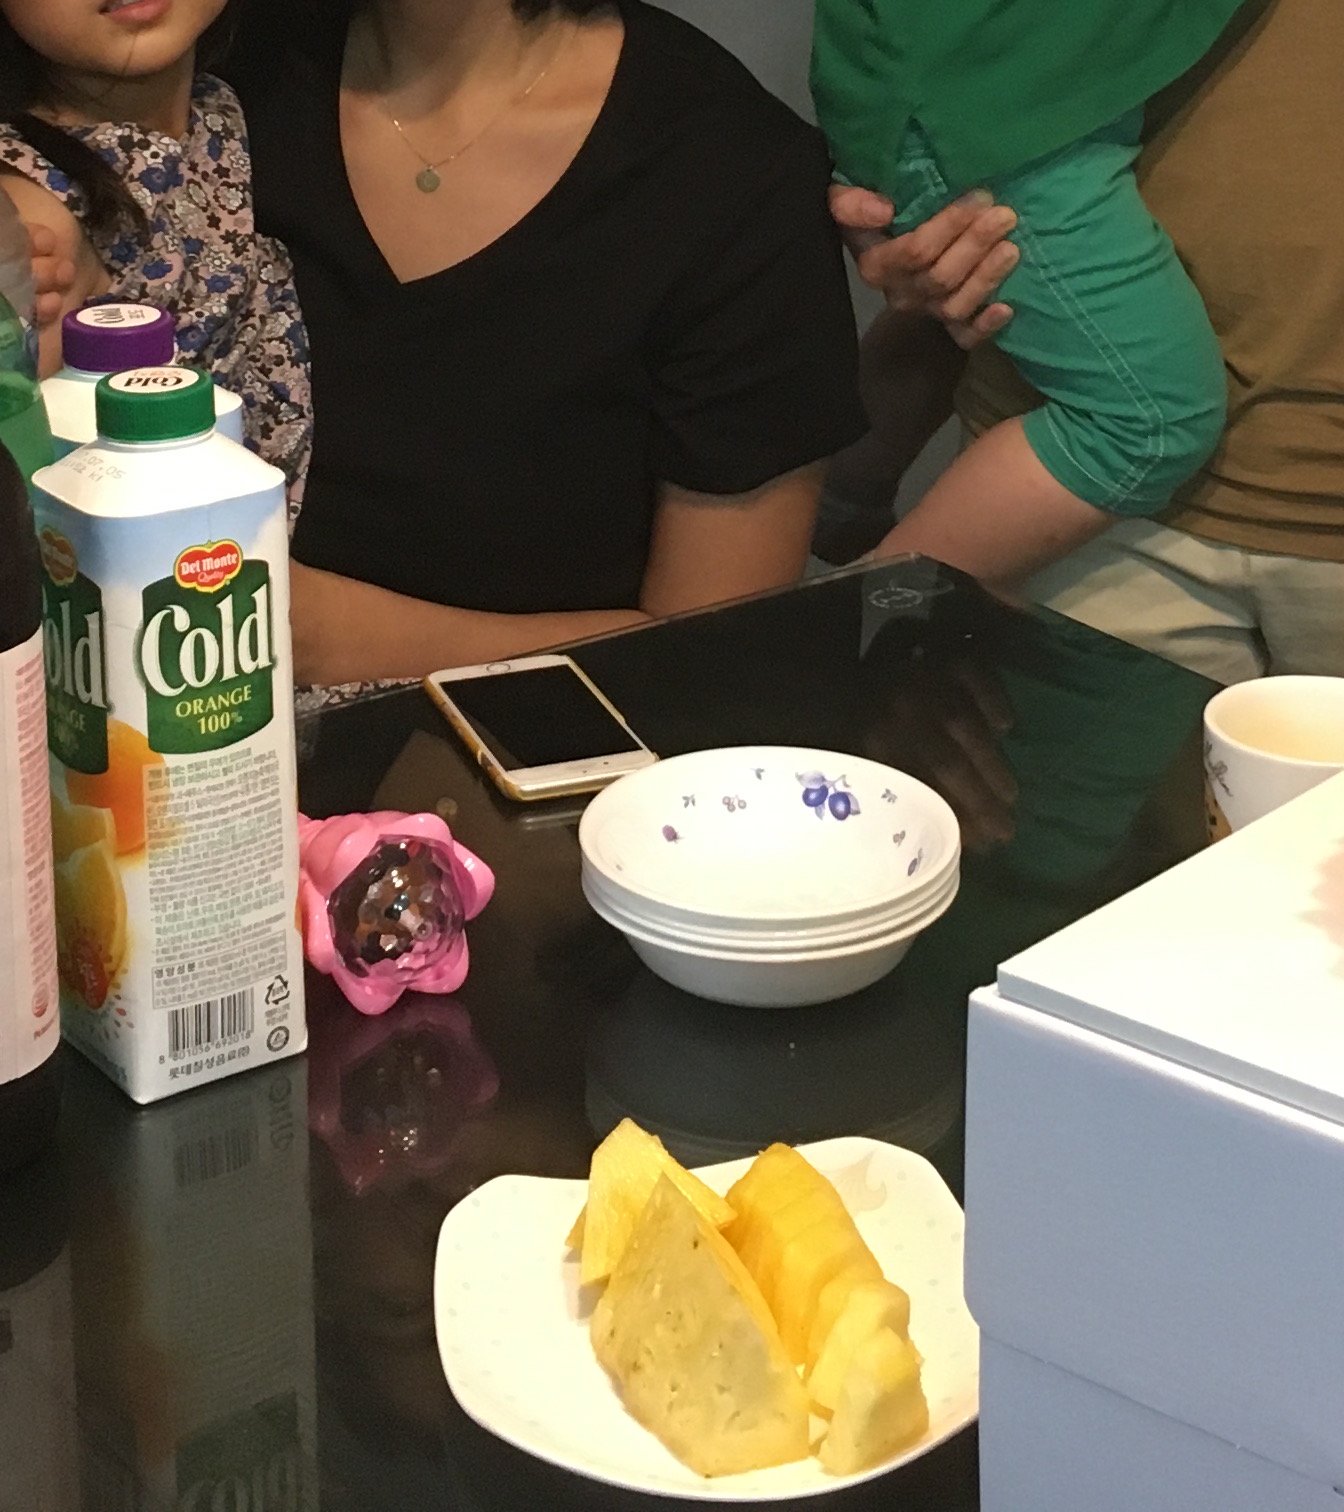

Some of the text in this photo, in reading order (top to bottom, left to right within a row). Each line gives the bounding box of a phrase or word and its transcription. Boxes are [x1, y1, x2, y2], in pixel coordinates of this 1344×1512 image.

[124, 376, 184, 388] Cold
[180, 553, 238, 575] Del Monte
[197, 570, 225, 584] Quality
[43, 598, 108, 709] old
[141, 583, 274, 698] Cold
[175, 684, 252, 719] ORANGE
[197, 712, 243, 735] 100%
[158, 1029, 252, 1065] 8 801056 692018
